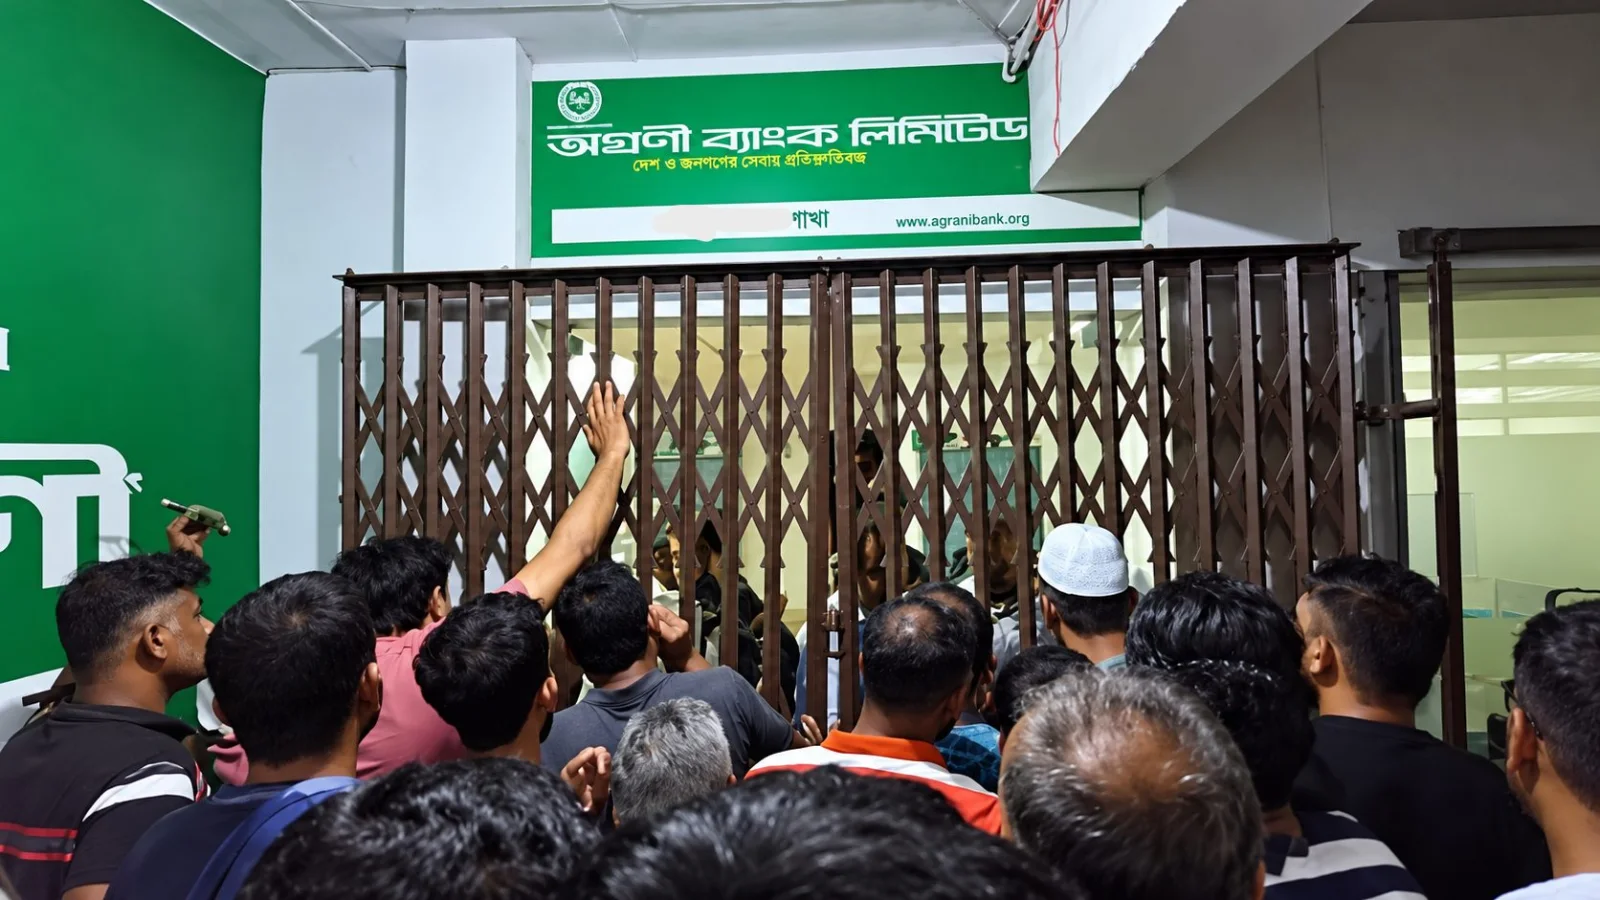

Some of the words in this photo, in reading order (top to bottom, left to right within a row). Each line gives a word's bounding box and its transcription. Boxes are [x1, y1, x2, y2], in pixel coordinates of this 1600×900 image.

[546, 124, 692, 157] অগ্রণী
[702, 124, 838, 153] ব্যাংক
[848, 113, 1028, 147] লিমিটেড
[633, 157, 660, 172] দেশ
[665, 157, 676, 170] ও
[895, 213, 1030, 228] www.agranibank.org
